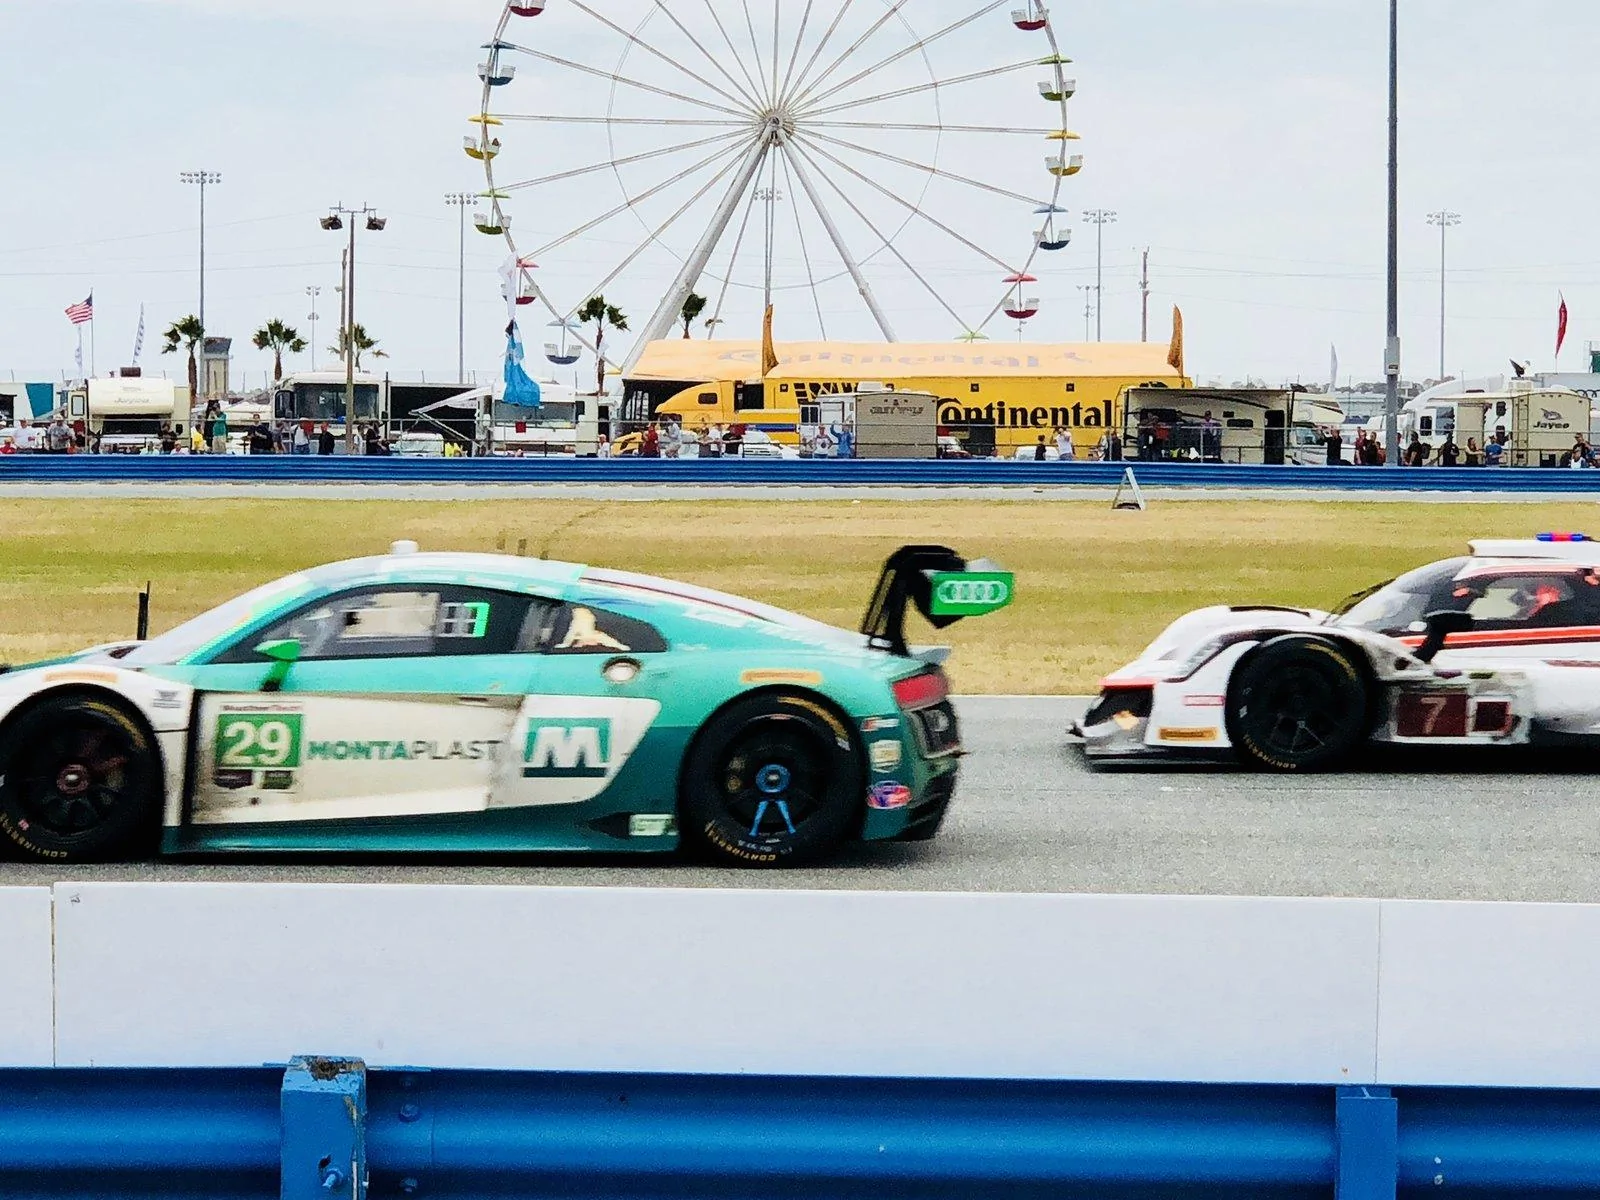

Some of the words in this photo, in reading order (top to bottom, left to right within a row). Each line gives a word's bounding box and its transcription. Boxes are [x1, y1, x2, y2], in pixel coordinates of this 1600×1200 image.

[1420, 697, 1447, 734] 7
[221, 720, 292, 765] 29
[306, 740, 503, 760] MONTAPLAST
